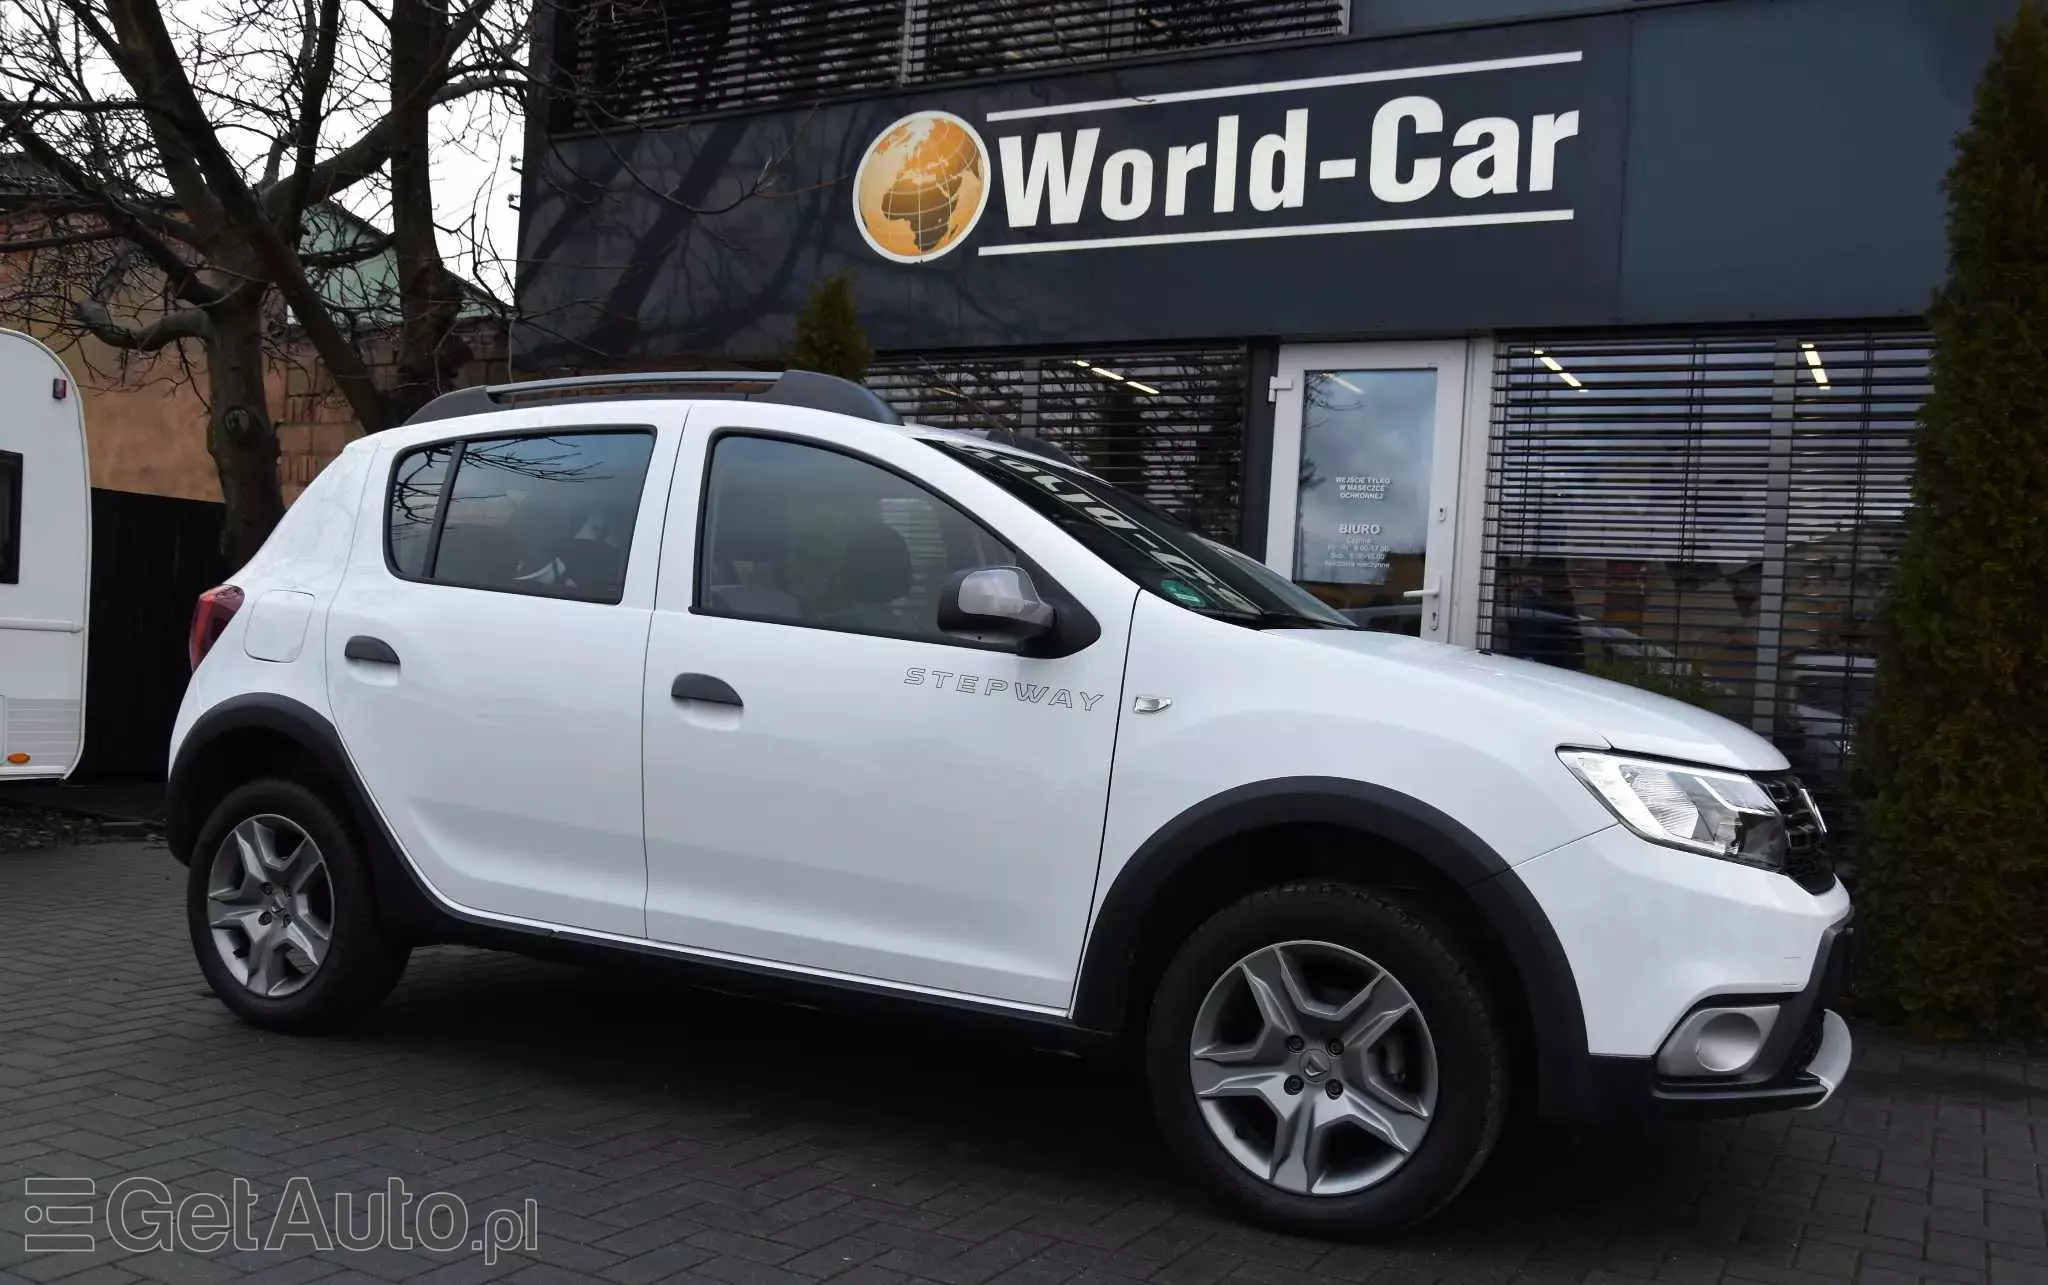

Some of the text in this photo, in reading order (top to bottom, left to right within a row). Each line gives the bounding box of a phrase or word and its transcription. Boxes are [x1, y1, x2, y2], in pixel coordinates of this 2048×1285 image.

[998, 95, 1580, 228] World-Car
[1339, 524, 1381, 535] BIURO
[903, 667, 1104, 712] STEPWAY
